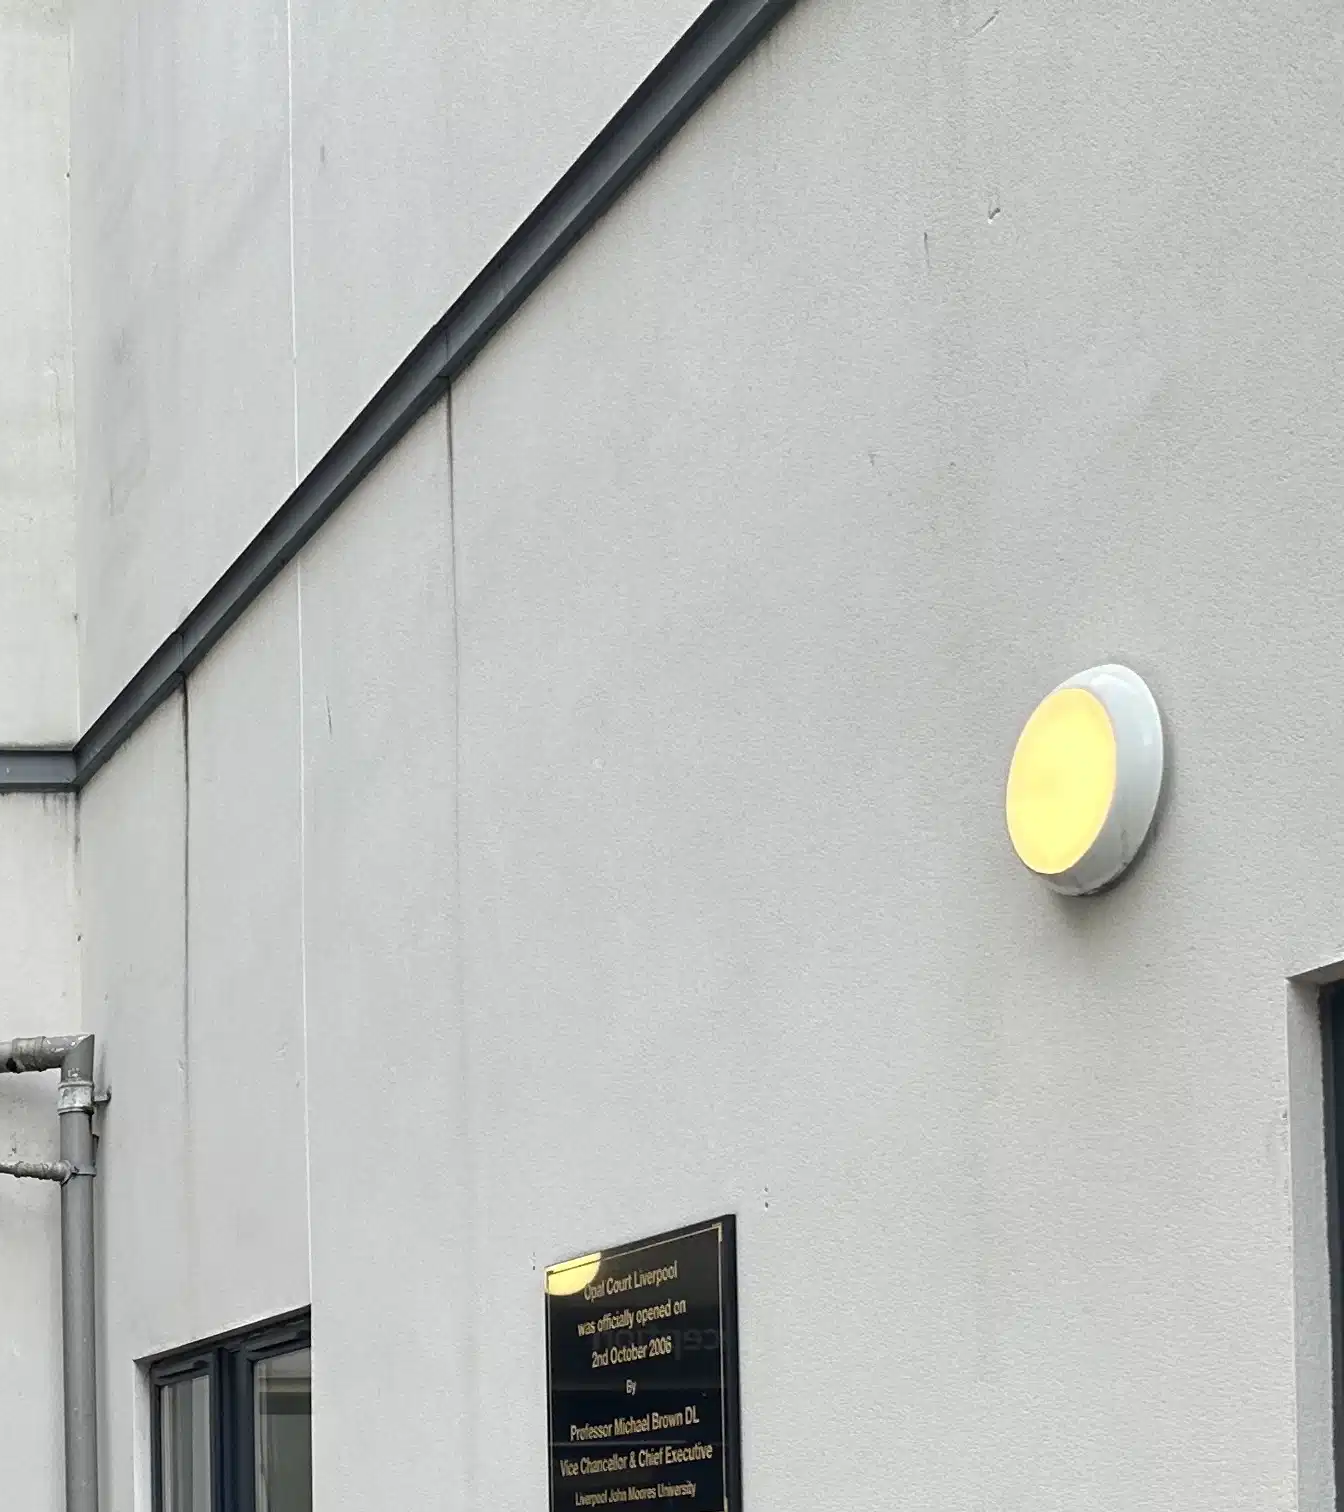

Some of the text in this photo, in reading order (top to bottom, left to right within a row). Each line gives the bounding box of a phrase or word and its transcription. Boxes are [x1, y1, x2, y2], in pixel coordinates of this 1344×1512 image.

[583, 1259, 678, 1303] Opal Court Liverpool
[577, 1298, 687, 1337] was officially opened on
[591, 1335, 672, 1369] 2nd October 2006
[625, 1379, 637, 1396] By
[570, 1405, 700, 1442] Professor Michael Brown DL
[560, 1441, 714, 1477] Vice Chancellor & Chief Executive
[575, 1489, 608, 1507] Liverpool
[608, 1487, 627, 1503] John
[657, 1480, 697, 1498] University
